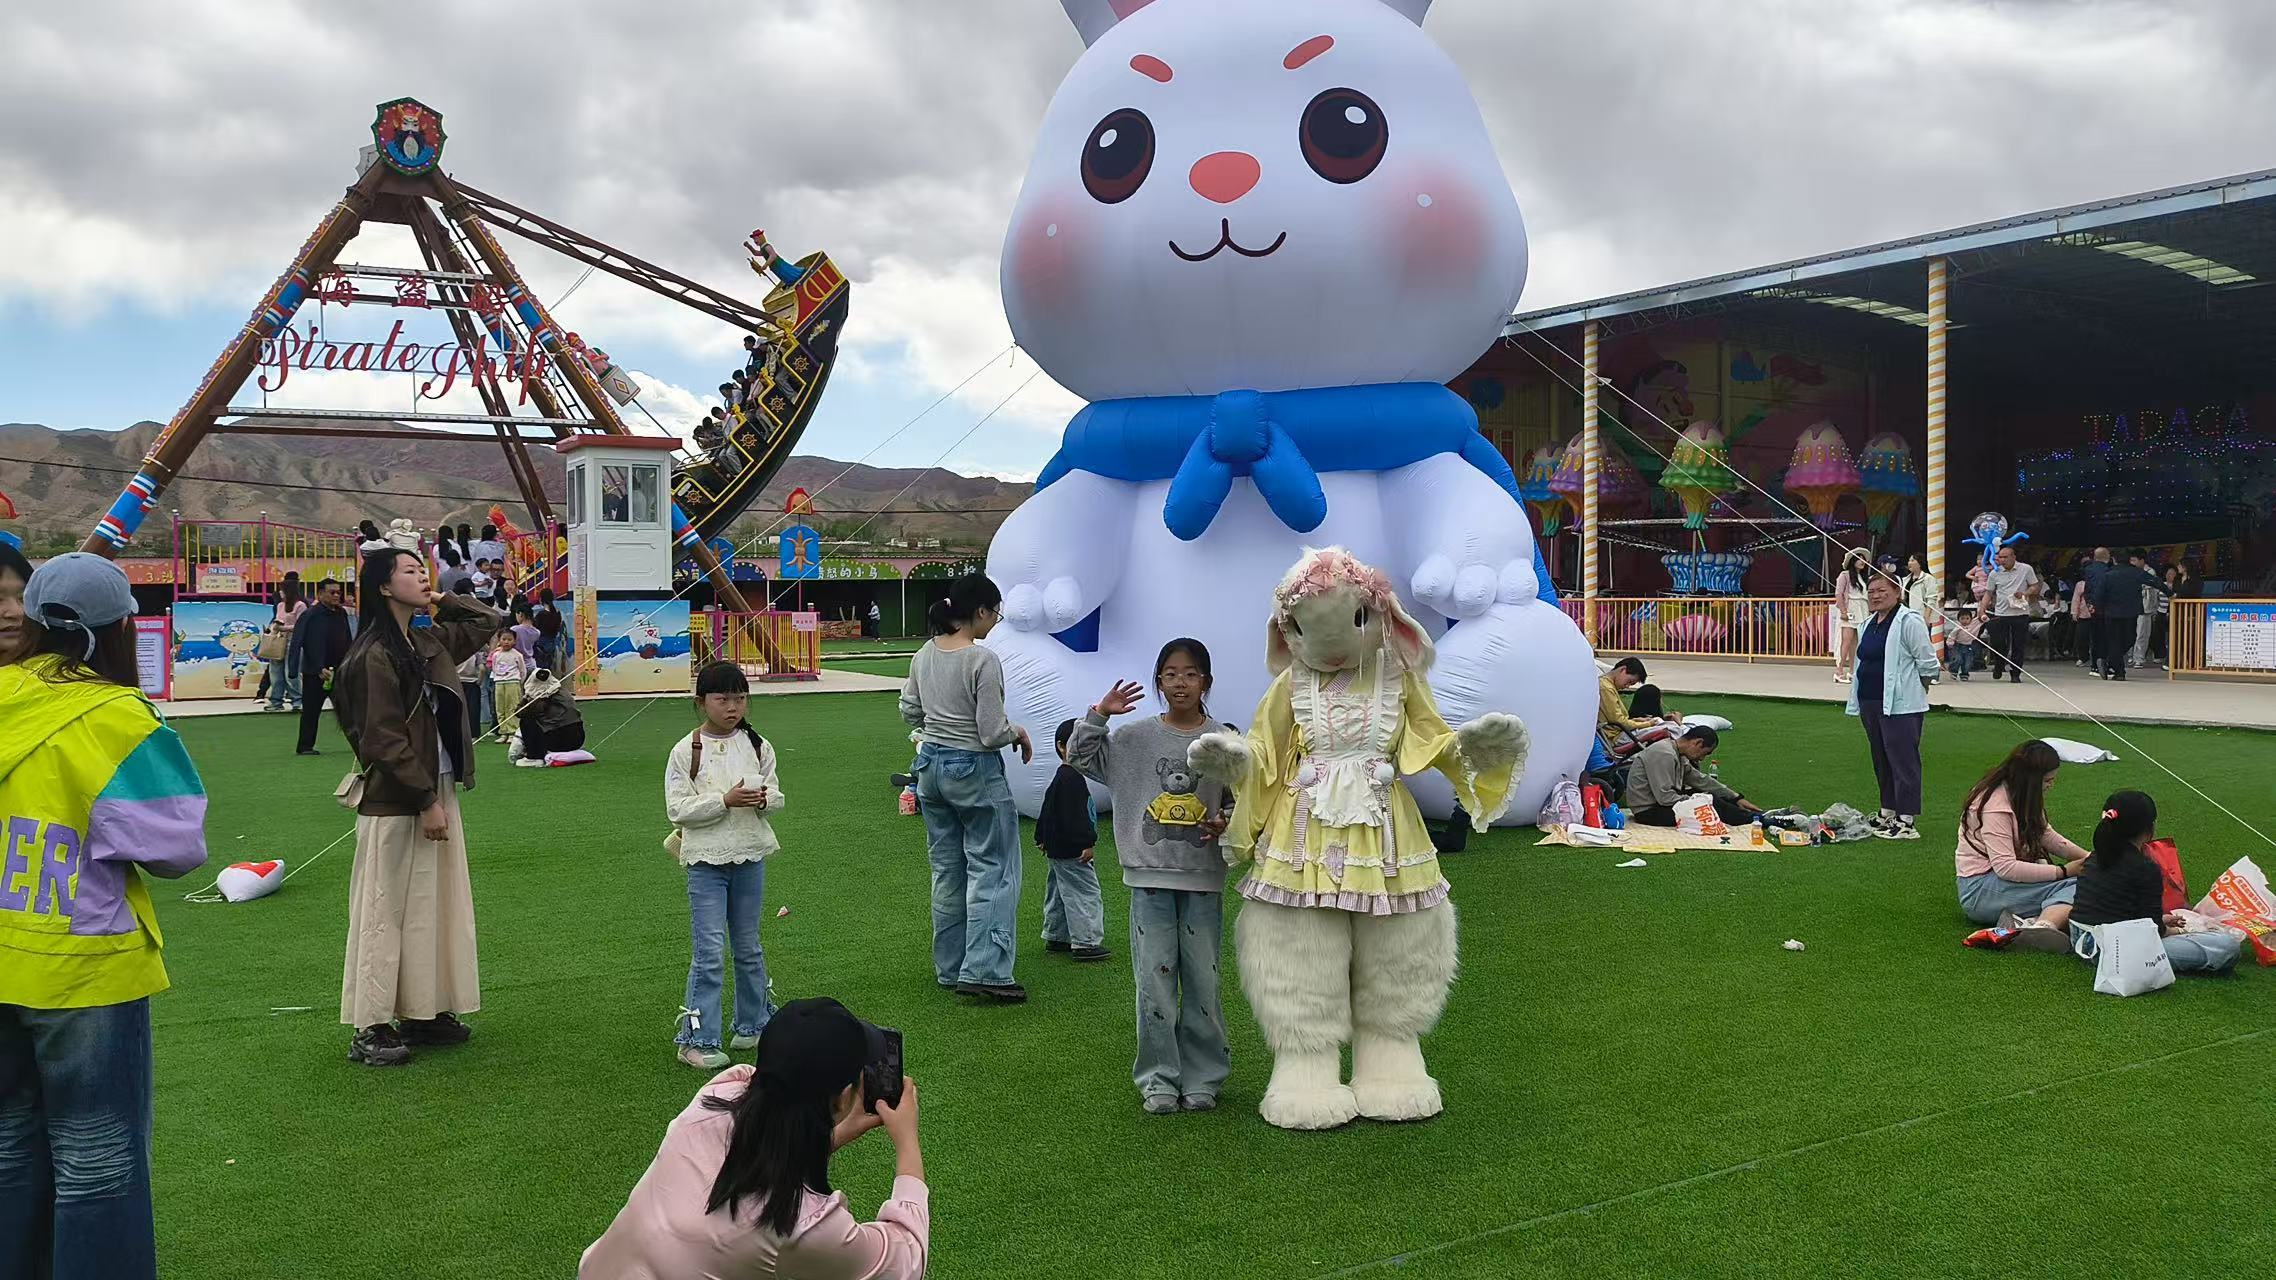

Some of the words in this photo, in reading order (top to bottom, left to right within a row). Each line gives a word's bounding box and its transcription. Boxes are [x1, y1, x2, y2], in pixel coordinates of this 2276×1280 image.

[254, 320, 432, 392] Pirate
[421, 331, 552, 406] Ship
[0, 815, 80, 916] ER
